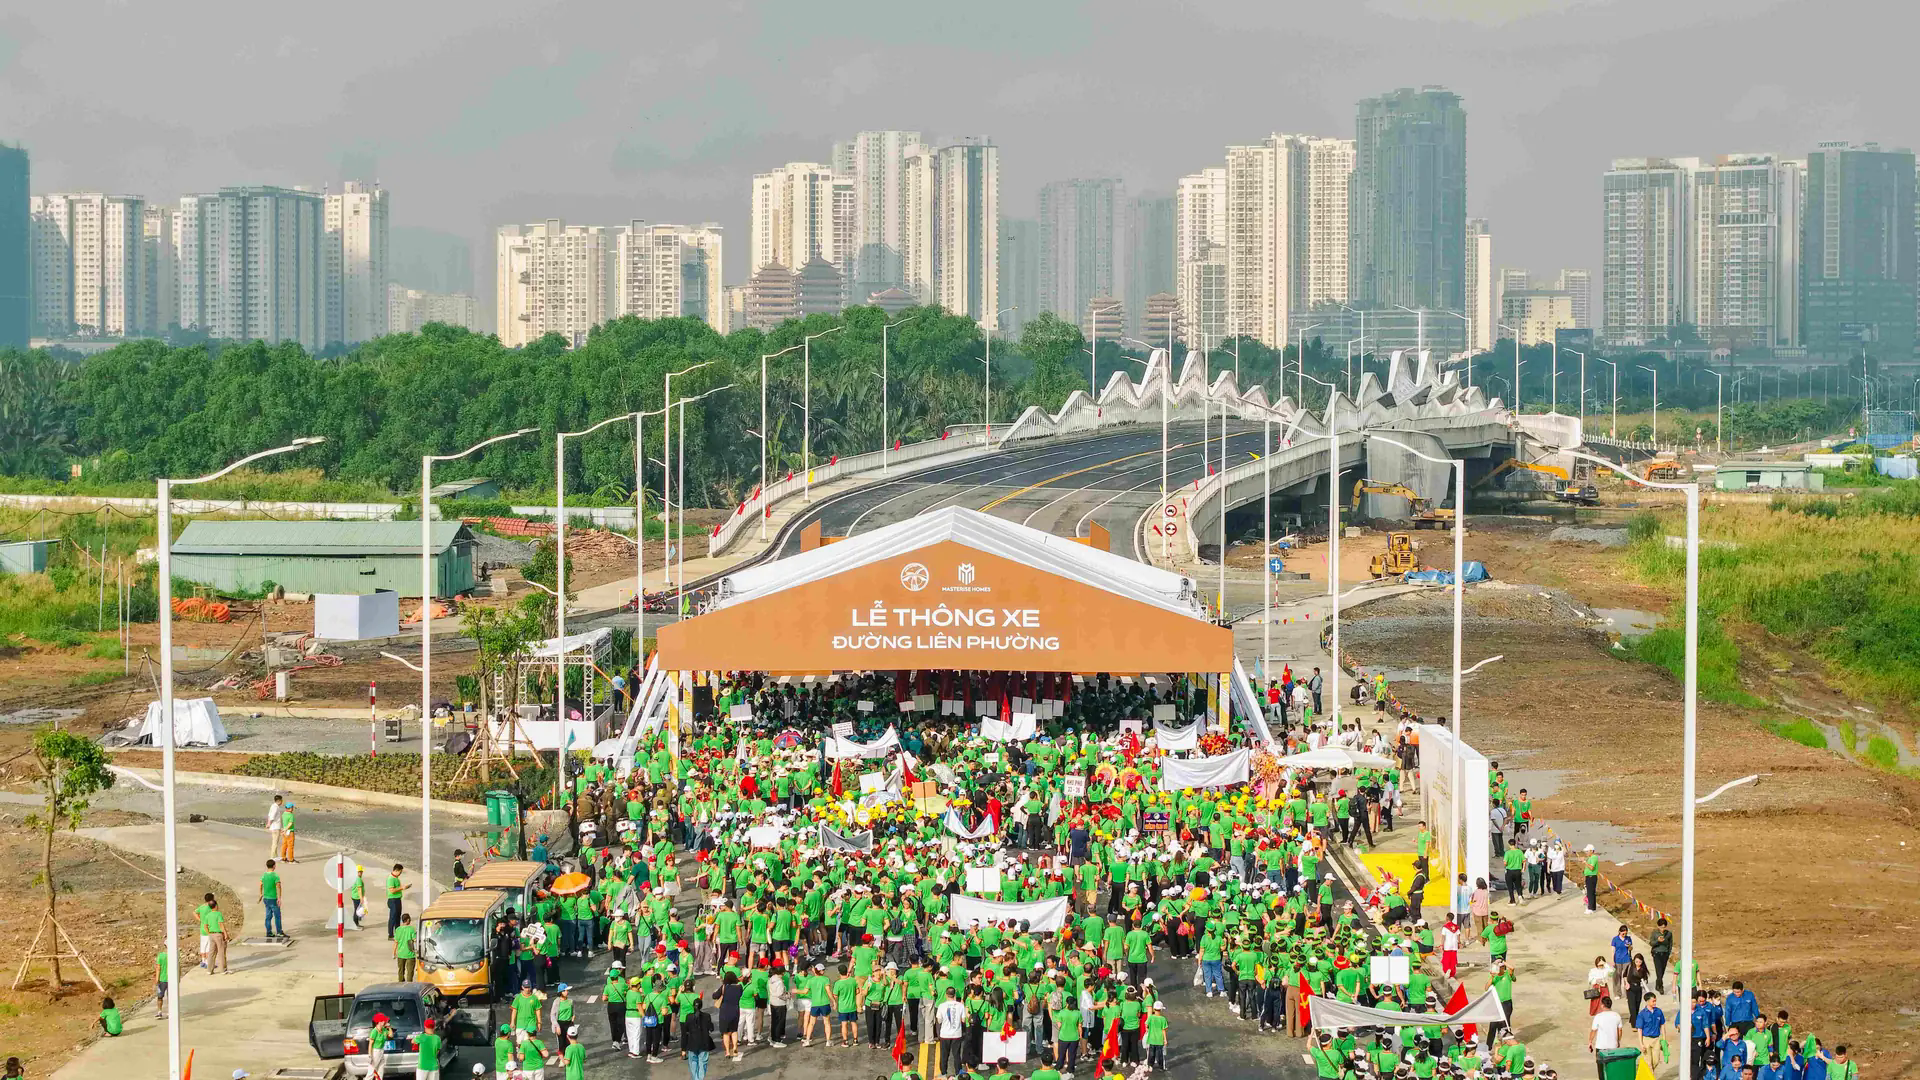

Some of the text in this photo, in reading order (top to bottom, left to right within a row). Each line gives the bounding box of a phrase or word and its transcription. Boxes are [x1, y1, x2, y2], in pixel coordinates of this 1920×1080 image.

[852, 600, 1040, 628] LỄ THÔNG XE
[832, 632, 1059, 651] ĐƯỜNG LIÊN PHƯỜNG
